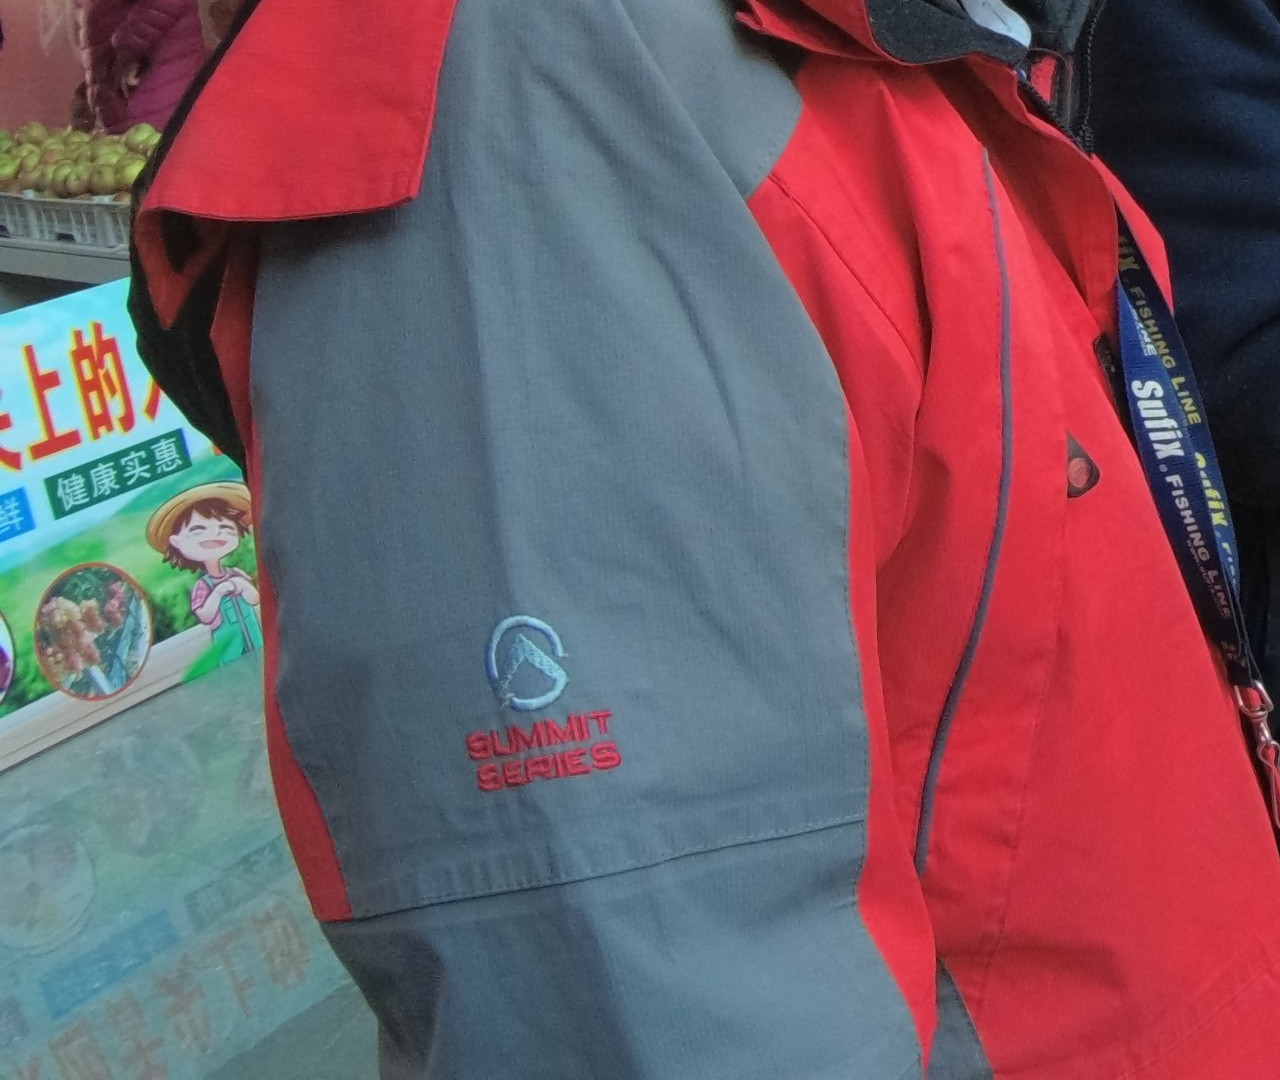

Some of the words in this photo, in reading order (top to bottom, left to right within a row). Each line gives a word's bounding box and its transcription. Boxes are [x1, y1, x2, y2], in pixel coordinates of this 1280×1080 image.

[1130, 286, 1177, 369] FISHING
[1171, 376, 1202, 425] LINE
[1131, 379, 1185, 460] Sufix
[56, 436, 184, 512] 健康实惠
[1165, 473, 1211, 562] FISHING
[1207, 568, 1232, 618] LINE
[465, 709, 613, 760] SUMMIT
[477, 741, 622, 793] SERIES
